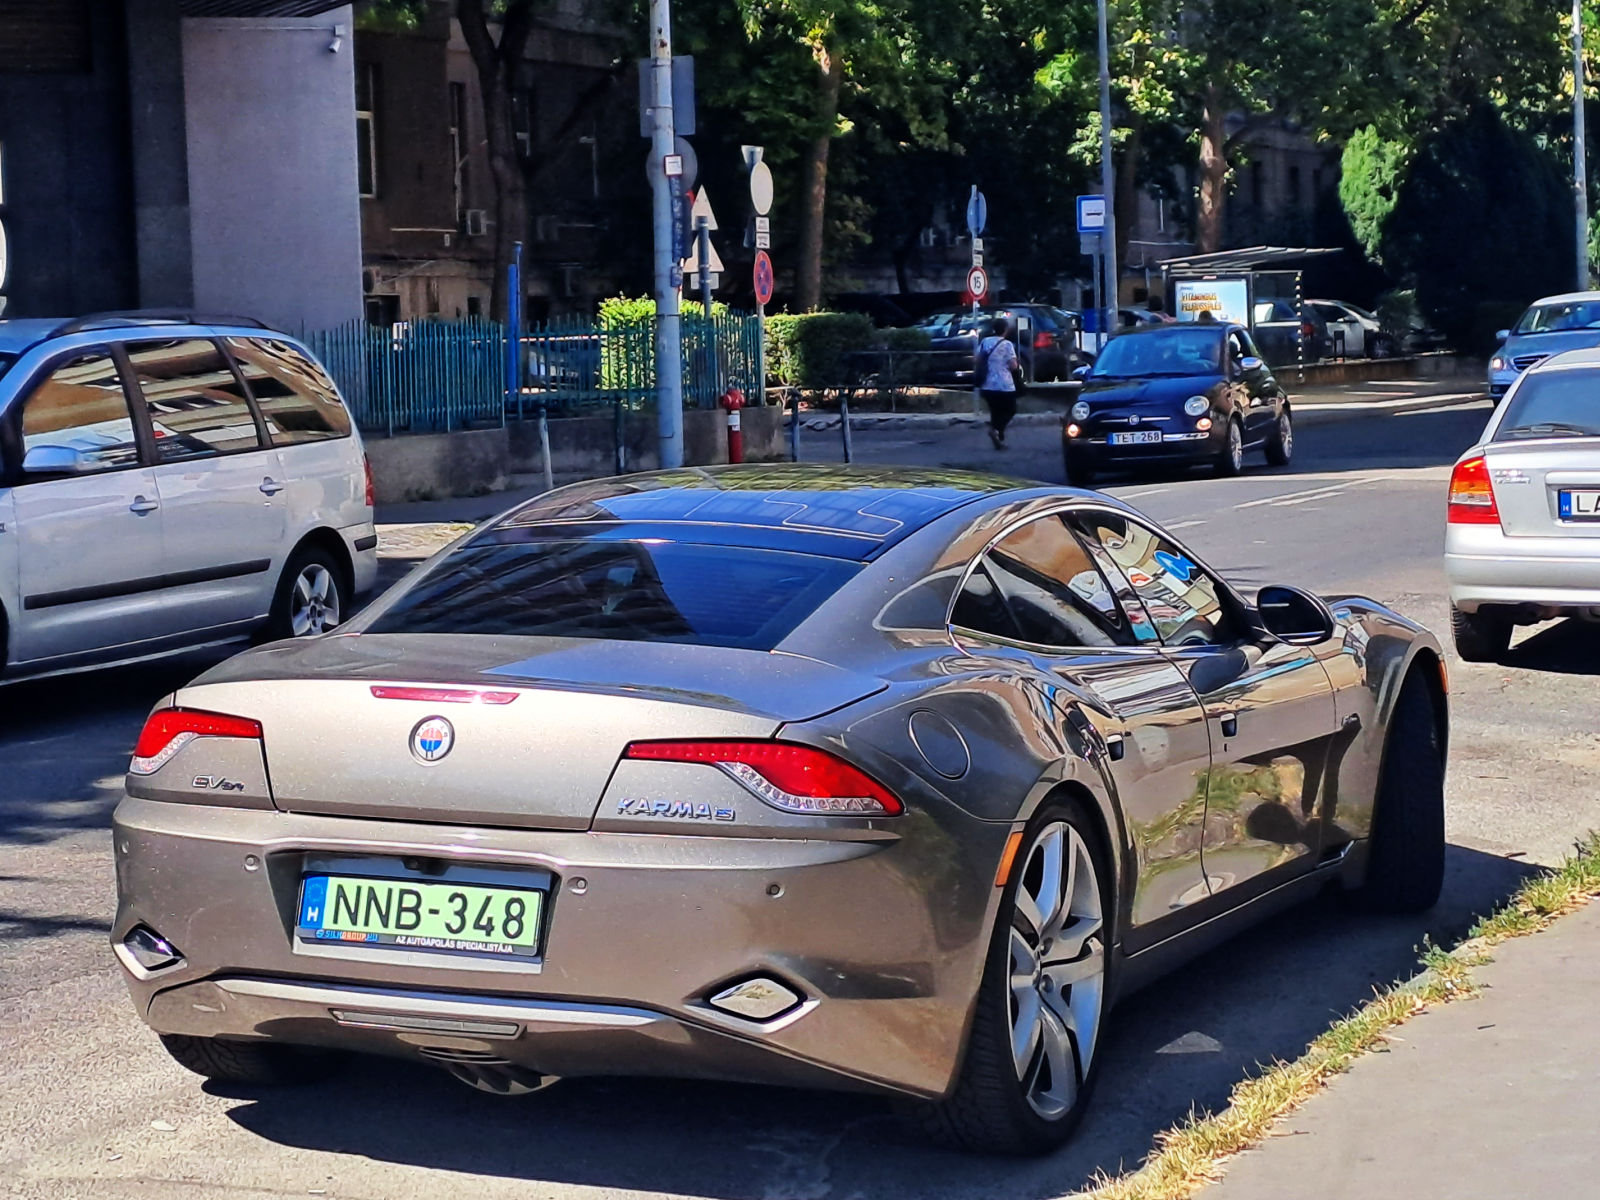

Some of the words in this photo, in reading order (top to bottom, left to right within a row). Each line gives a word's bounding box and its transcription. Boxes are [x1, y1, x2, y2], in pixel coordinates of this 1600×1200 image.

[974, 276, 982, 289] 15
[617, 798, 712, 819] KARMA
[306, 906, 319, 923] H
[333, 884, 525, 939] NNB-348
